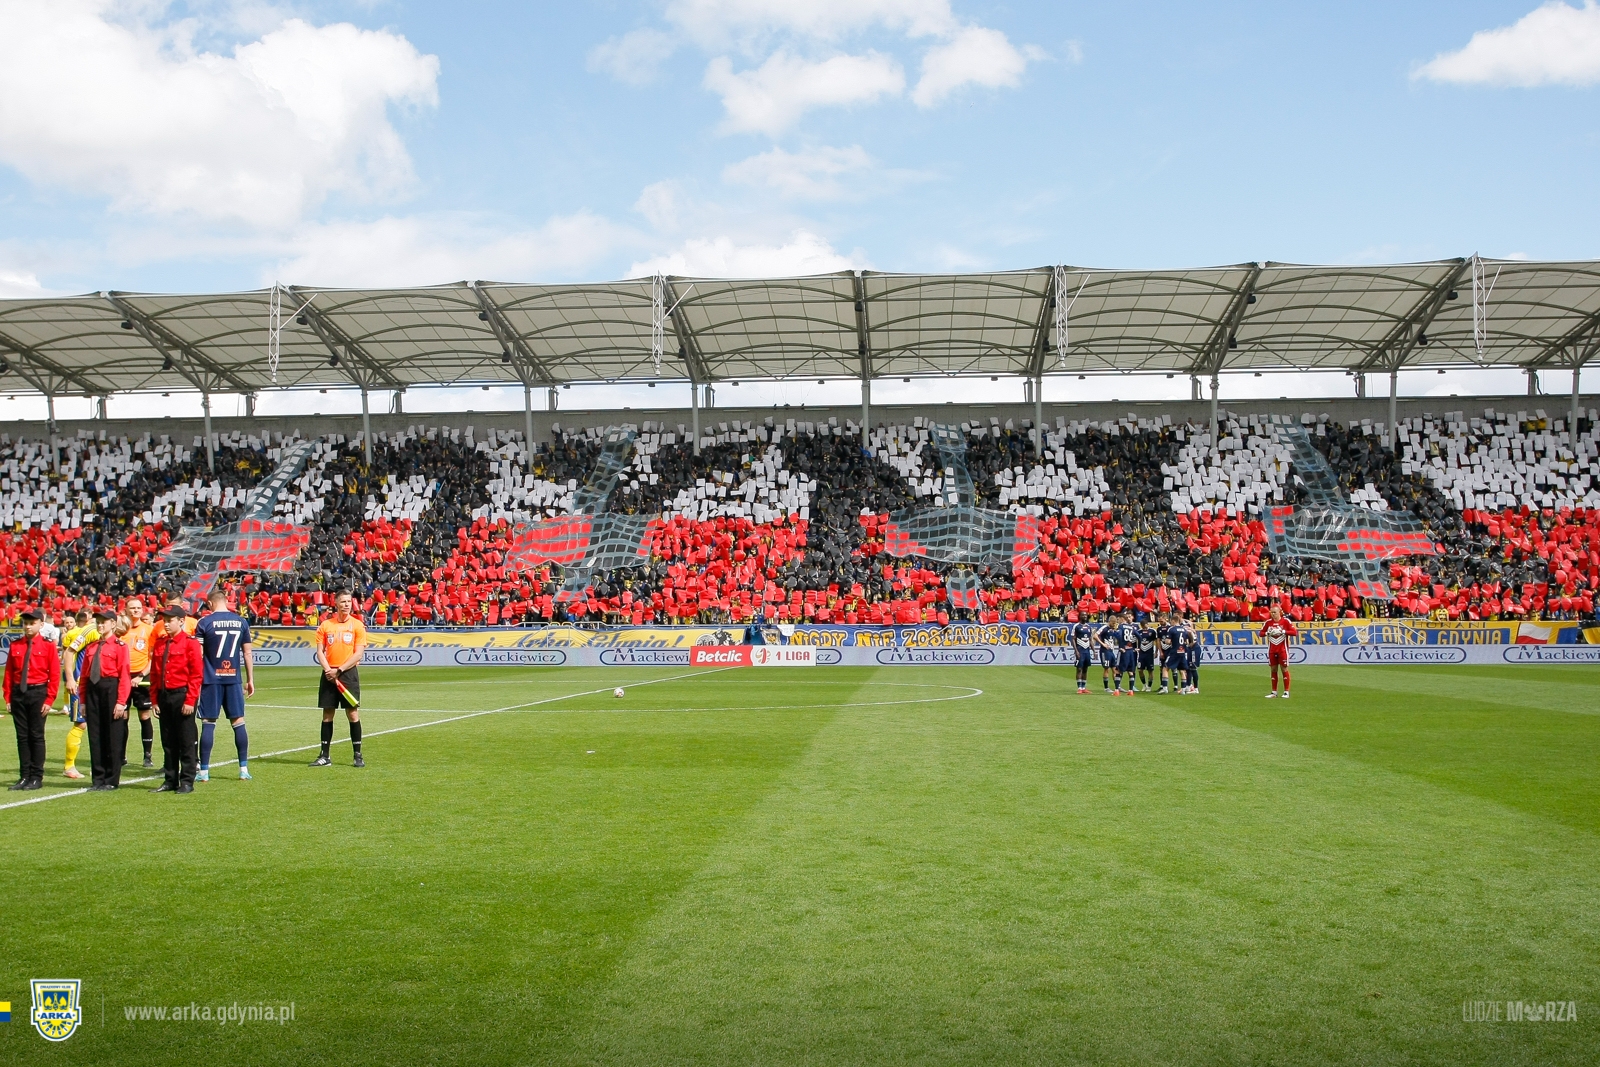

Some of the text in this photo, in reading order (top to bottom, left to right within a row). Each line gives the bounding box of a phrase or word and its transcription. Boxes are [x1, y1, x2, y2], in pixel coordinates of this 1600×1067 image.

[213, 620, 241, 628] PUTIVTSEV
[214, 630, 241, 658] 77
[1028, 627, 1069, 647] SAM
[1437, 629, 1502, 646] GDYNIA
[467, 648, 556, 662] Mackiewicz
[613, 648, 689, 662] Mackiewi
[696, 650, 742, 663] Betclic
[776, 651, 781, 661] 1
[785, 651, 810, 661] LIGA
[889, 647, 984, 662] Mackiewicz
[1357, 645, 1456, 660] Mackiewicz
[1517, 645, 1600, 660] Mackiewi
